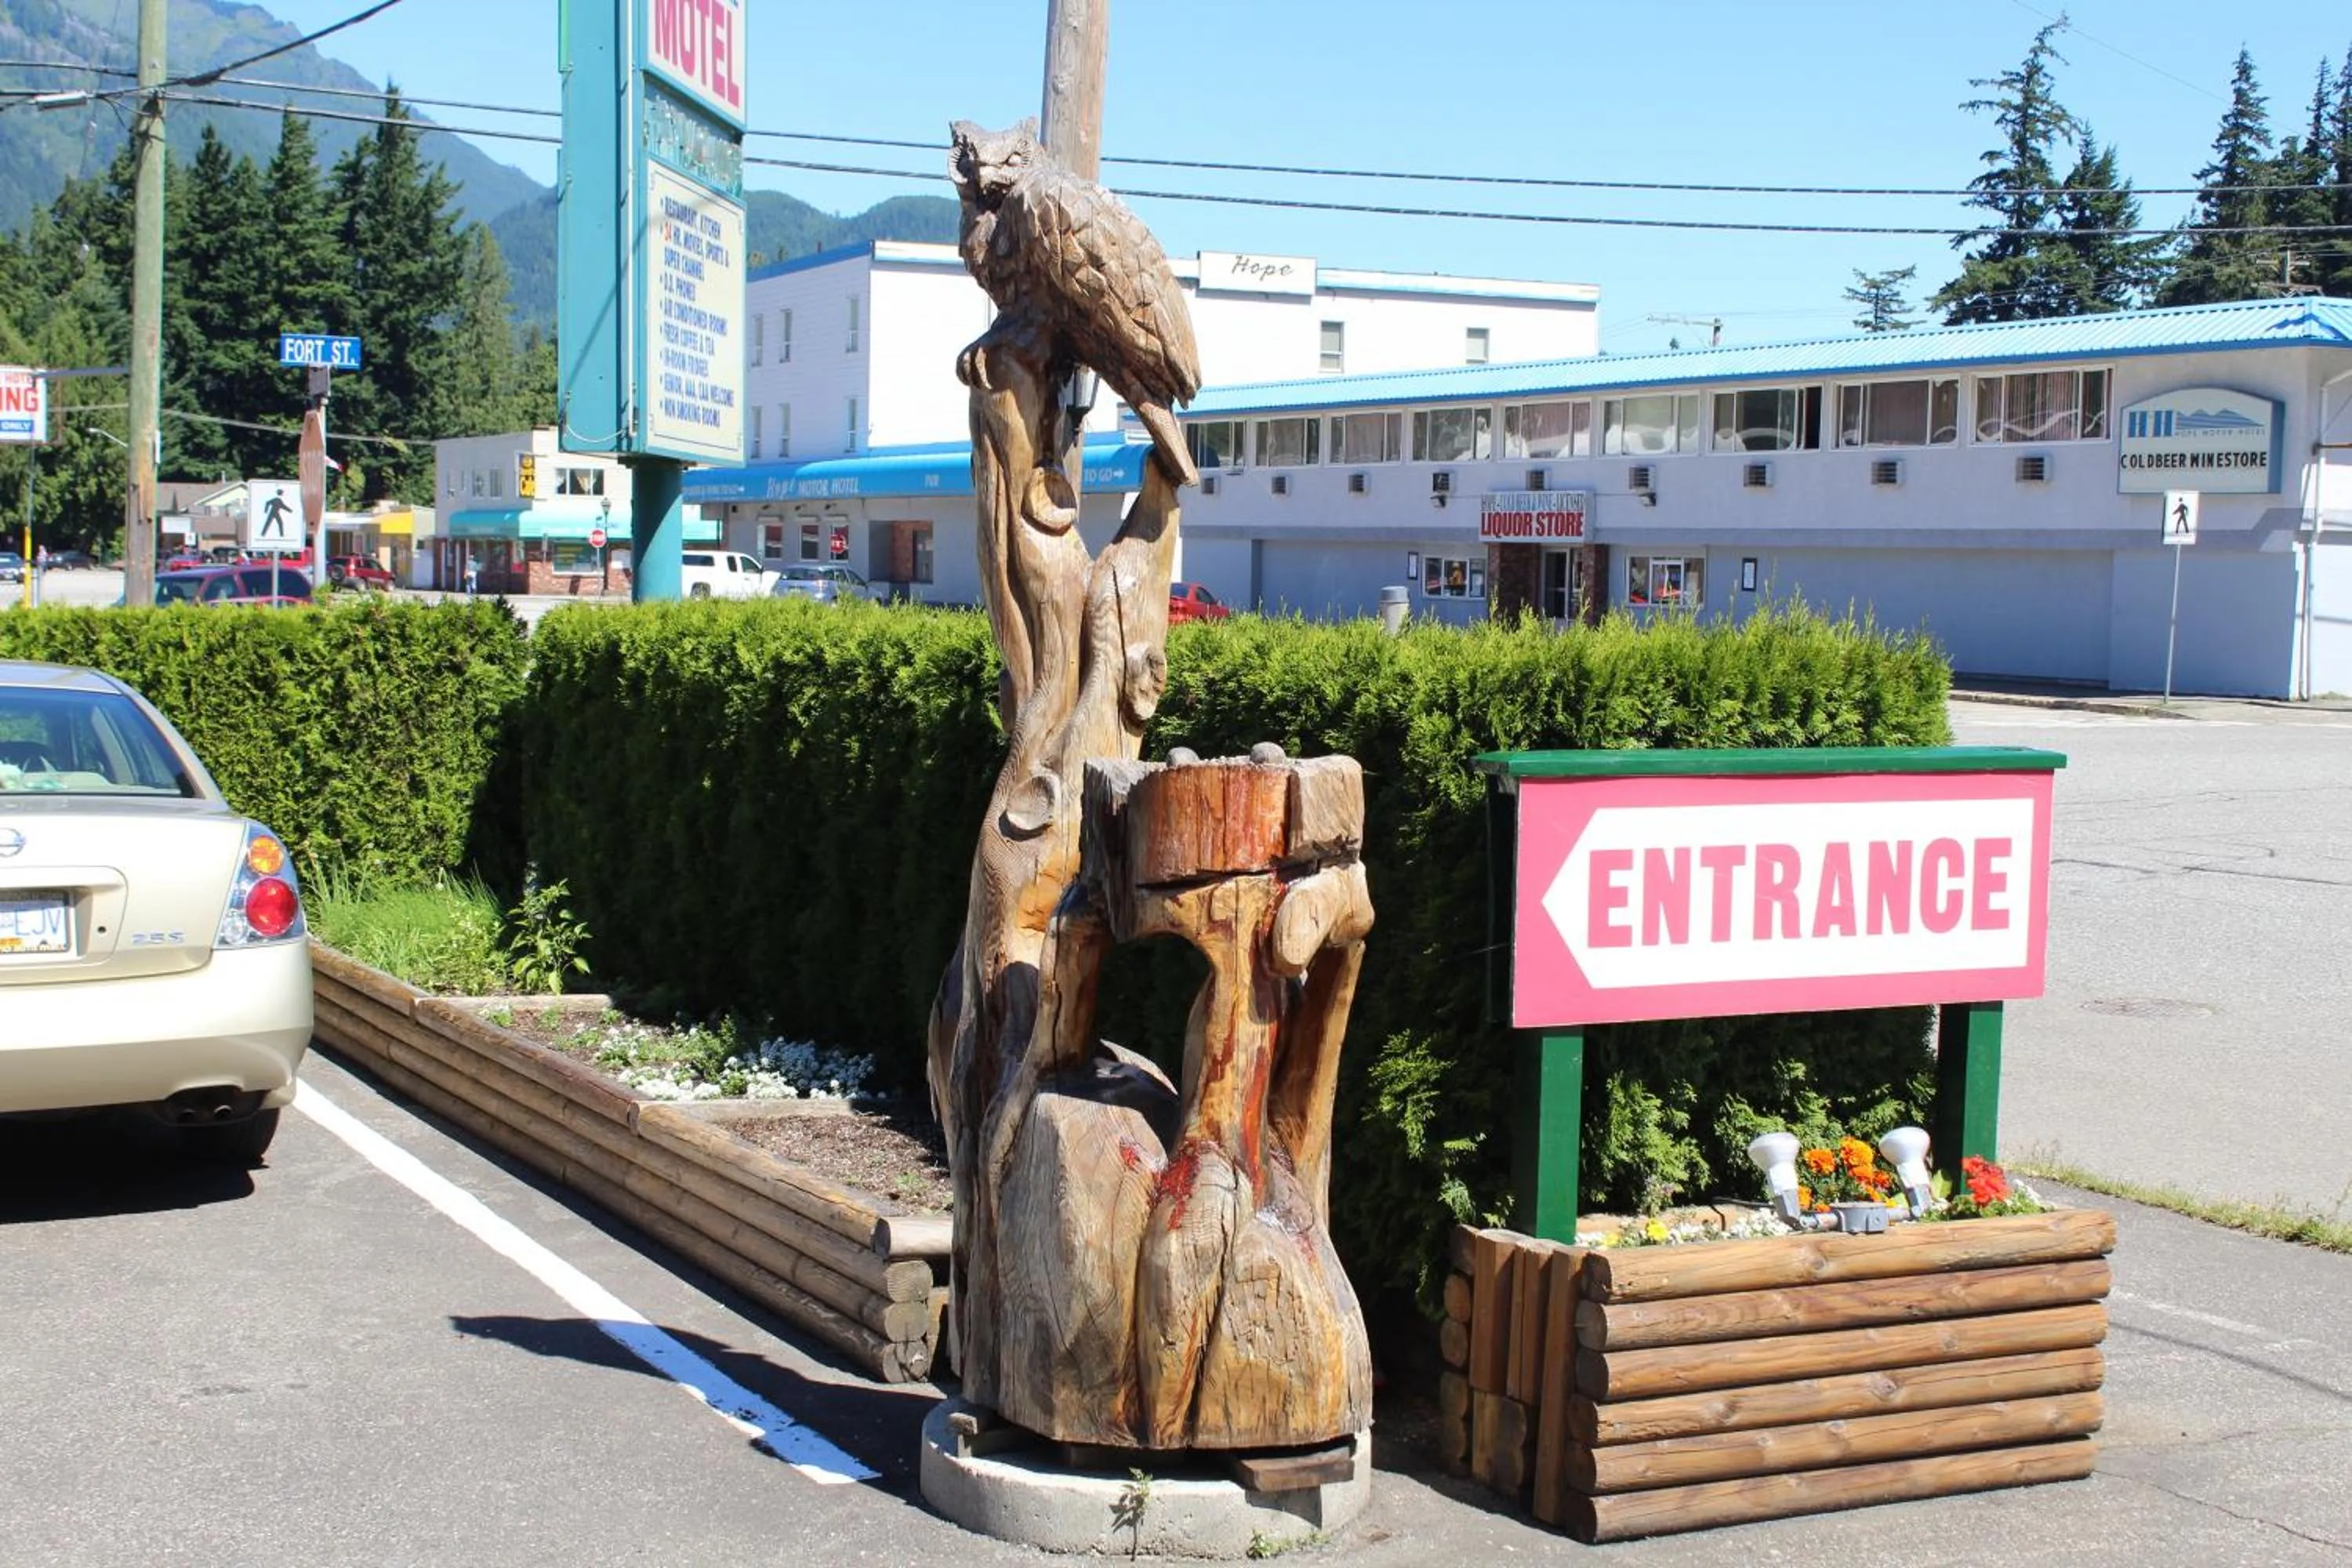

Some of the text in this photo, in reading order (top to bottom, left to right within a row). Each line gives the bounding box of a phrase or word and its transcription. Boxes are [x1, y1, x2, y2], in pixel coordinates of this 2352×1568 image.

[664, 246, 704, 281] SUPER CHANNEL
[706, 240, 723, 265] SPORTS
[1232, 253, 1294, 281] Hope
[676, 278, 695, 303] PHONES
[674, 301, 707, 330] CONDITIONED
[709, 314, 727, 337] ROOMS
[285, 338, 356, 365] FORT ST.
[664, 322, 678, 346] FRESH
[681, 328, 698, 351] COFFEE
[705, 336, 714, 356] TEA
[699, 382, 708, 401] CAA
[710, 384, 734, 408] WELCOME
[664, 397, 720, 428] NON SMOKING ROOMS
[799, 479, 829, 497] MOTOR
[831, 476, 858, 495] HOTEL
[1481, 512, 1584, 538] LIQUOR STORE
[1588, 837, 2012, 948] ENTRANCE
